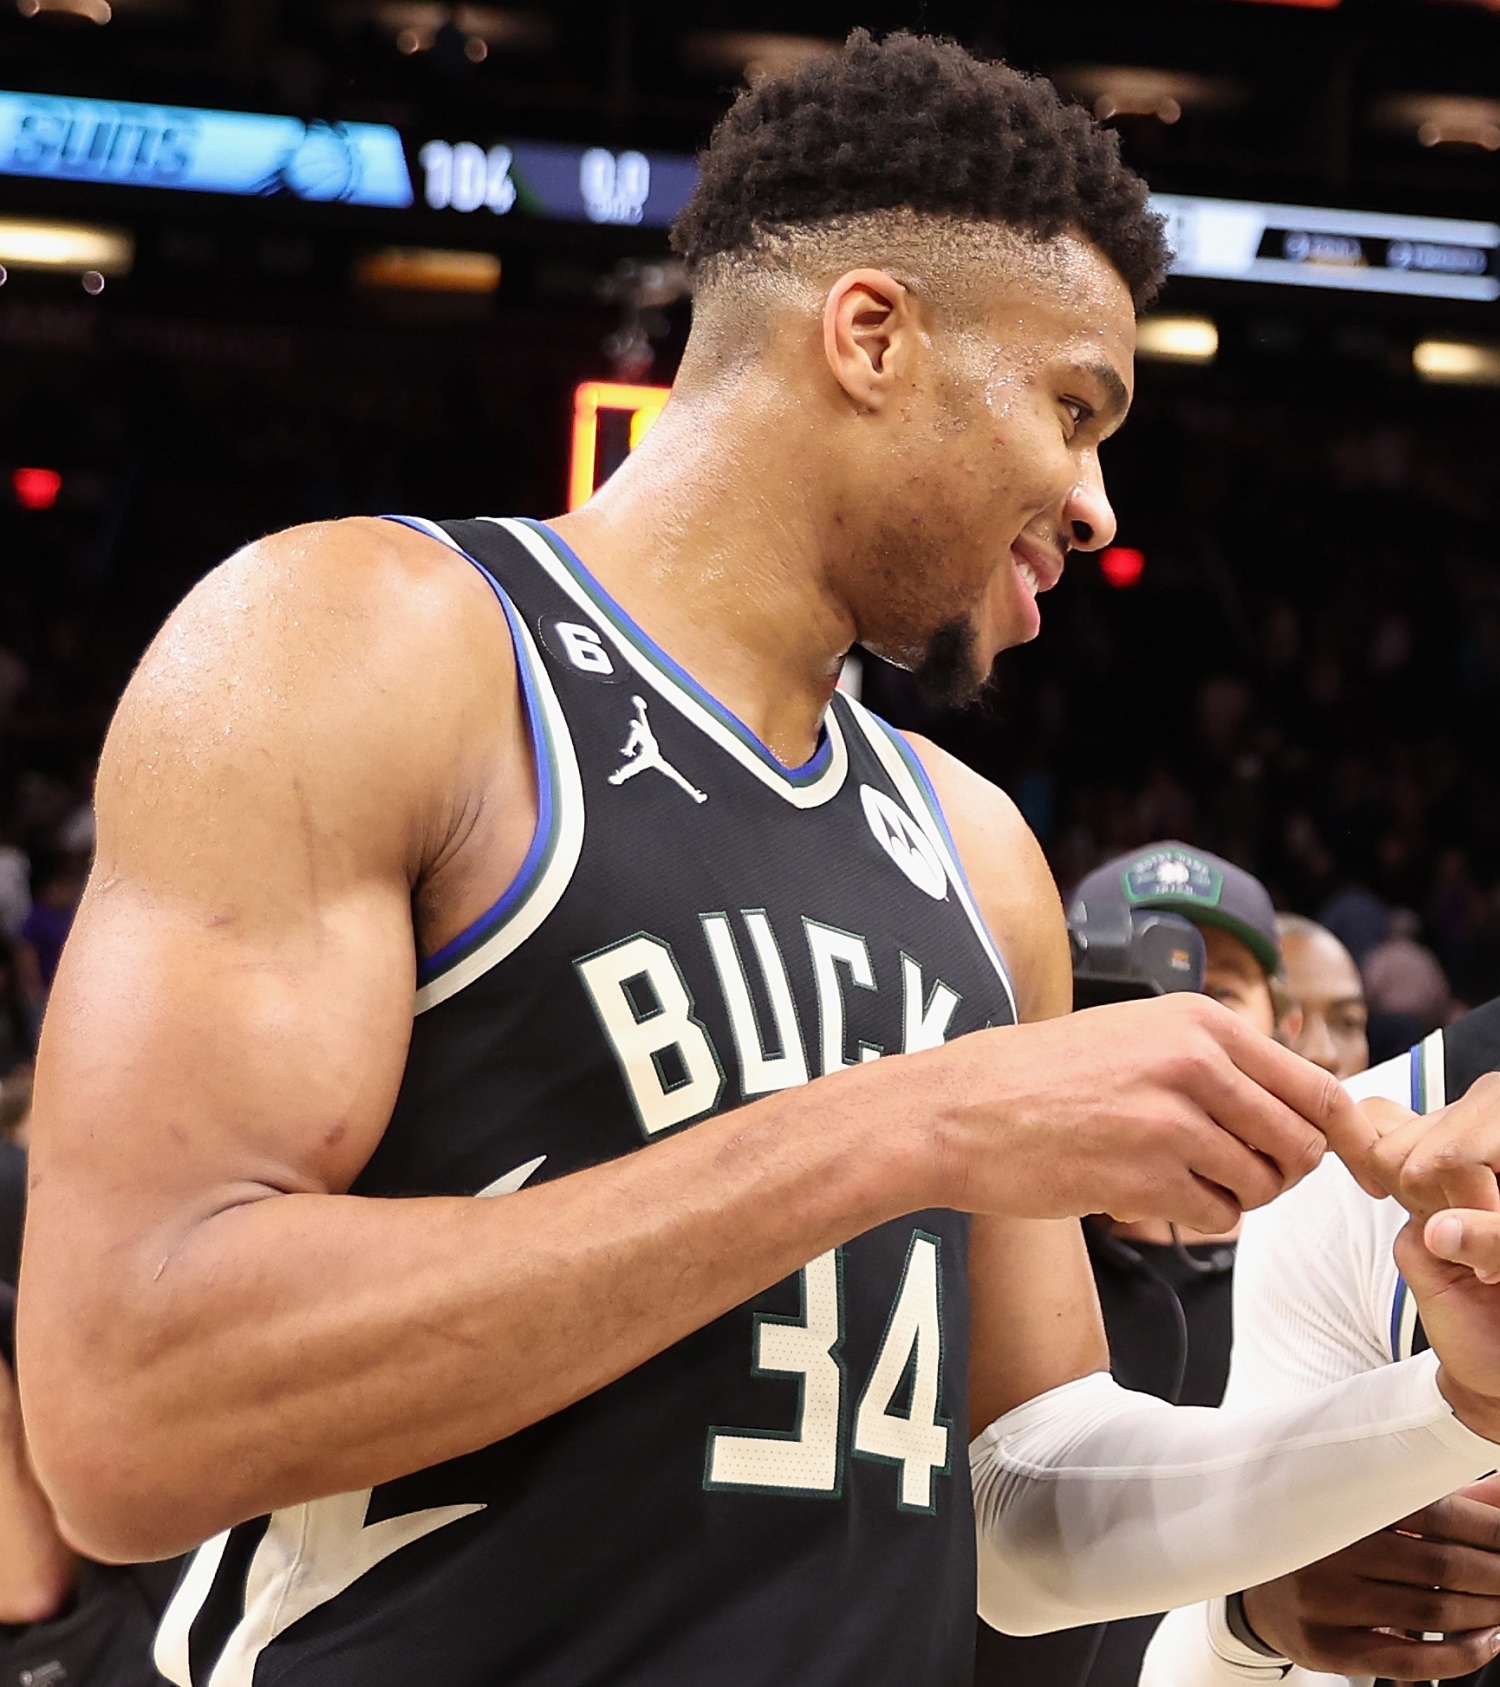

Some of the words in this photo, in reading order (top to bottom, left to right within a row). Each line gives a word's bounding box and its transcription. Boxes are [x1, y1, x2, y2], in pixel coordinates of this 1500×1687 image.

[555, 621, 614, 676] 6
[572, 908, 995, 1141] BUCK
[703, 1228, 953, 1516] 34
